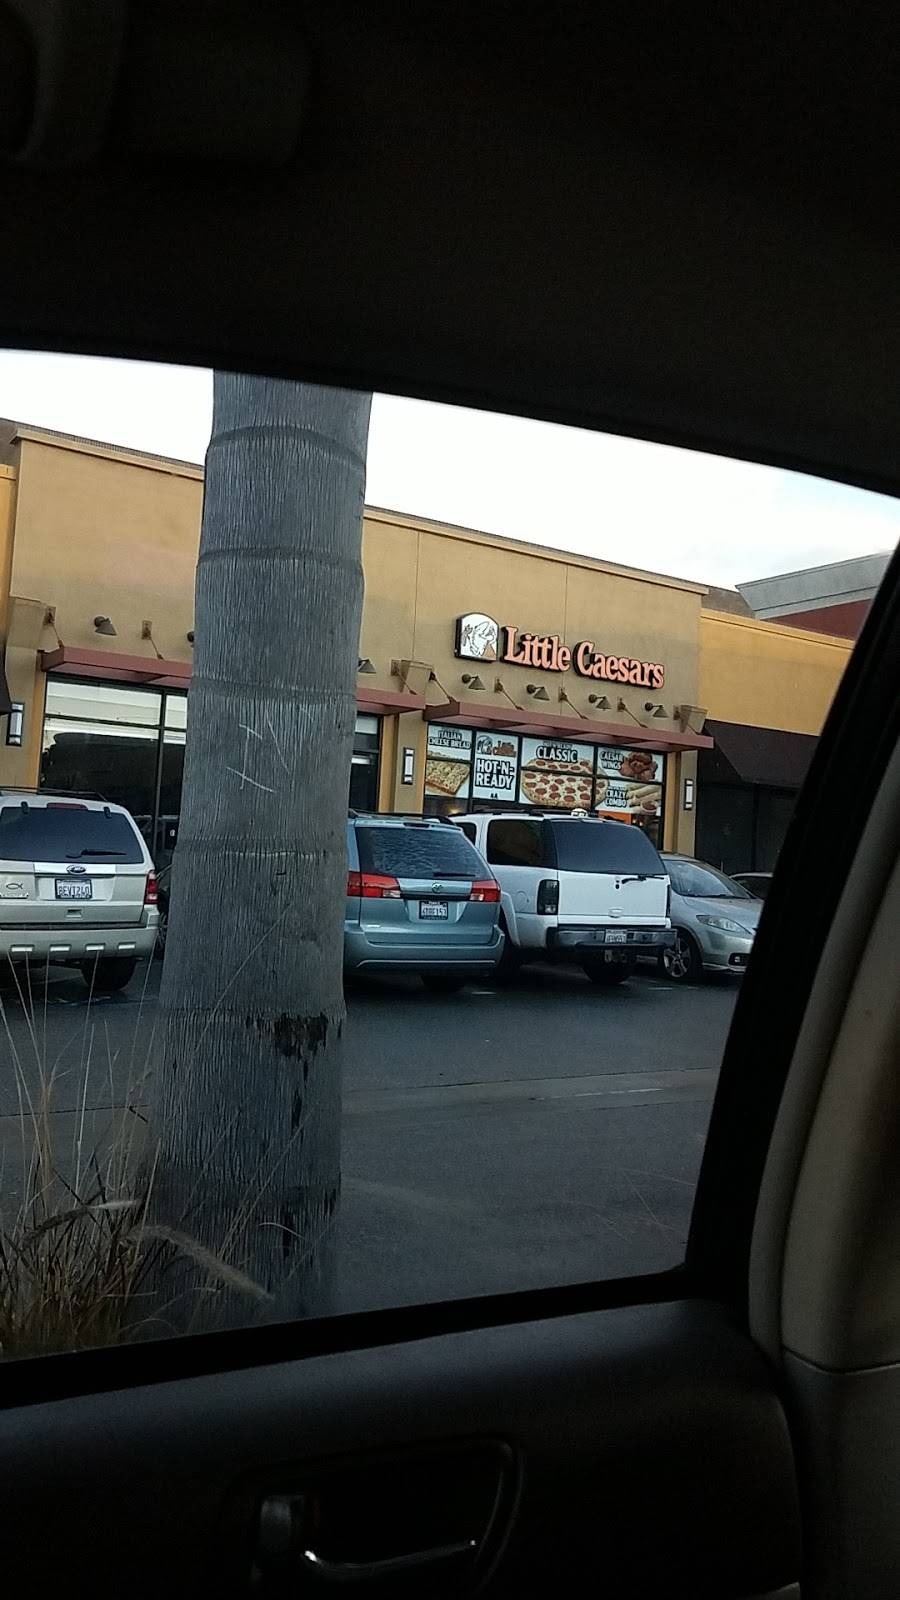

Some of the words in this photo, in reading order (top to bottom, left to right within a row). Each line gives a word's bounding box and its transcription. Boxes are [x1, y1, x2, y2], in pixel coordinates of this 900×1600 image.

[502, 626, 571, 672] Little
[574, 641, 664, 689] Caesars
[536, 746, 578, 763] CLASSIC
[475, 773, 514, 790] READY
